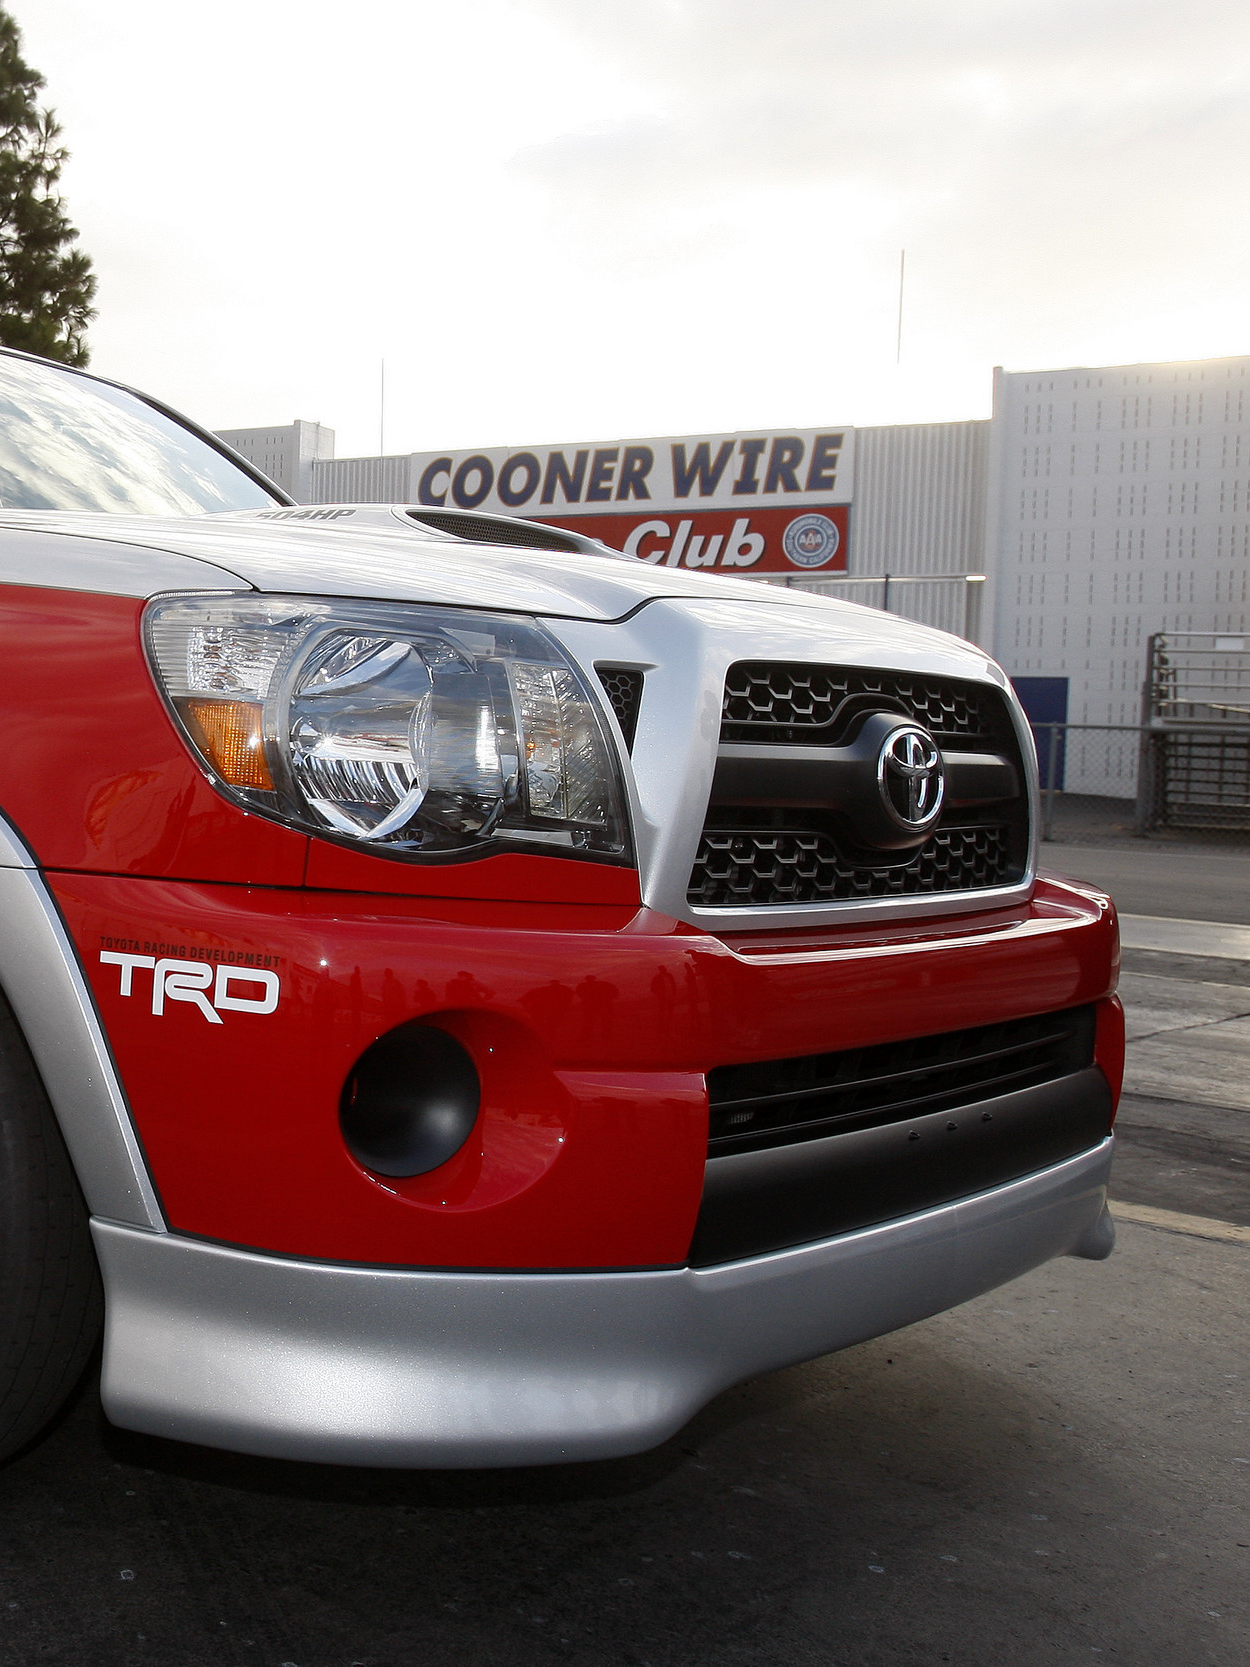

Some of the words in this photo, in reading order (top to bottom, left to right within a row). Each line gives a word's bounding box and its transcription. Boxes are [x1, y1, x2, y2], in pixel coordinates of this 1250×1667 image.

[418, 445, 655, 509] COONER
[670, 432, 845, 499] WIRE
[622, 517, 766, 569] Club
[799, 532, 822, 546] AAA
[100, 936, 141, 951] TOYOTA
[144, 941, 187, 958] RACING
[190, 946, 281, 968] DEVELOPMENT
[99, 950, 281, 1025] TRD
